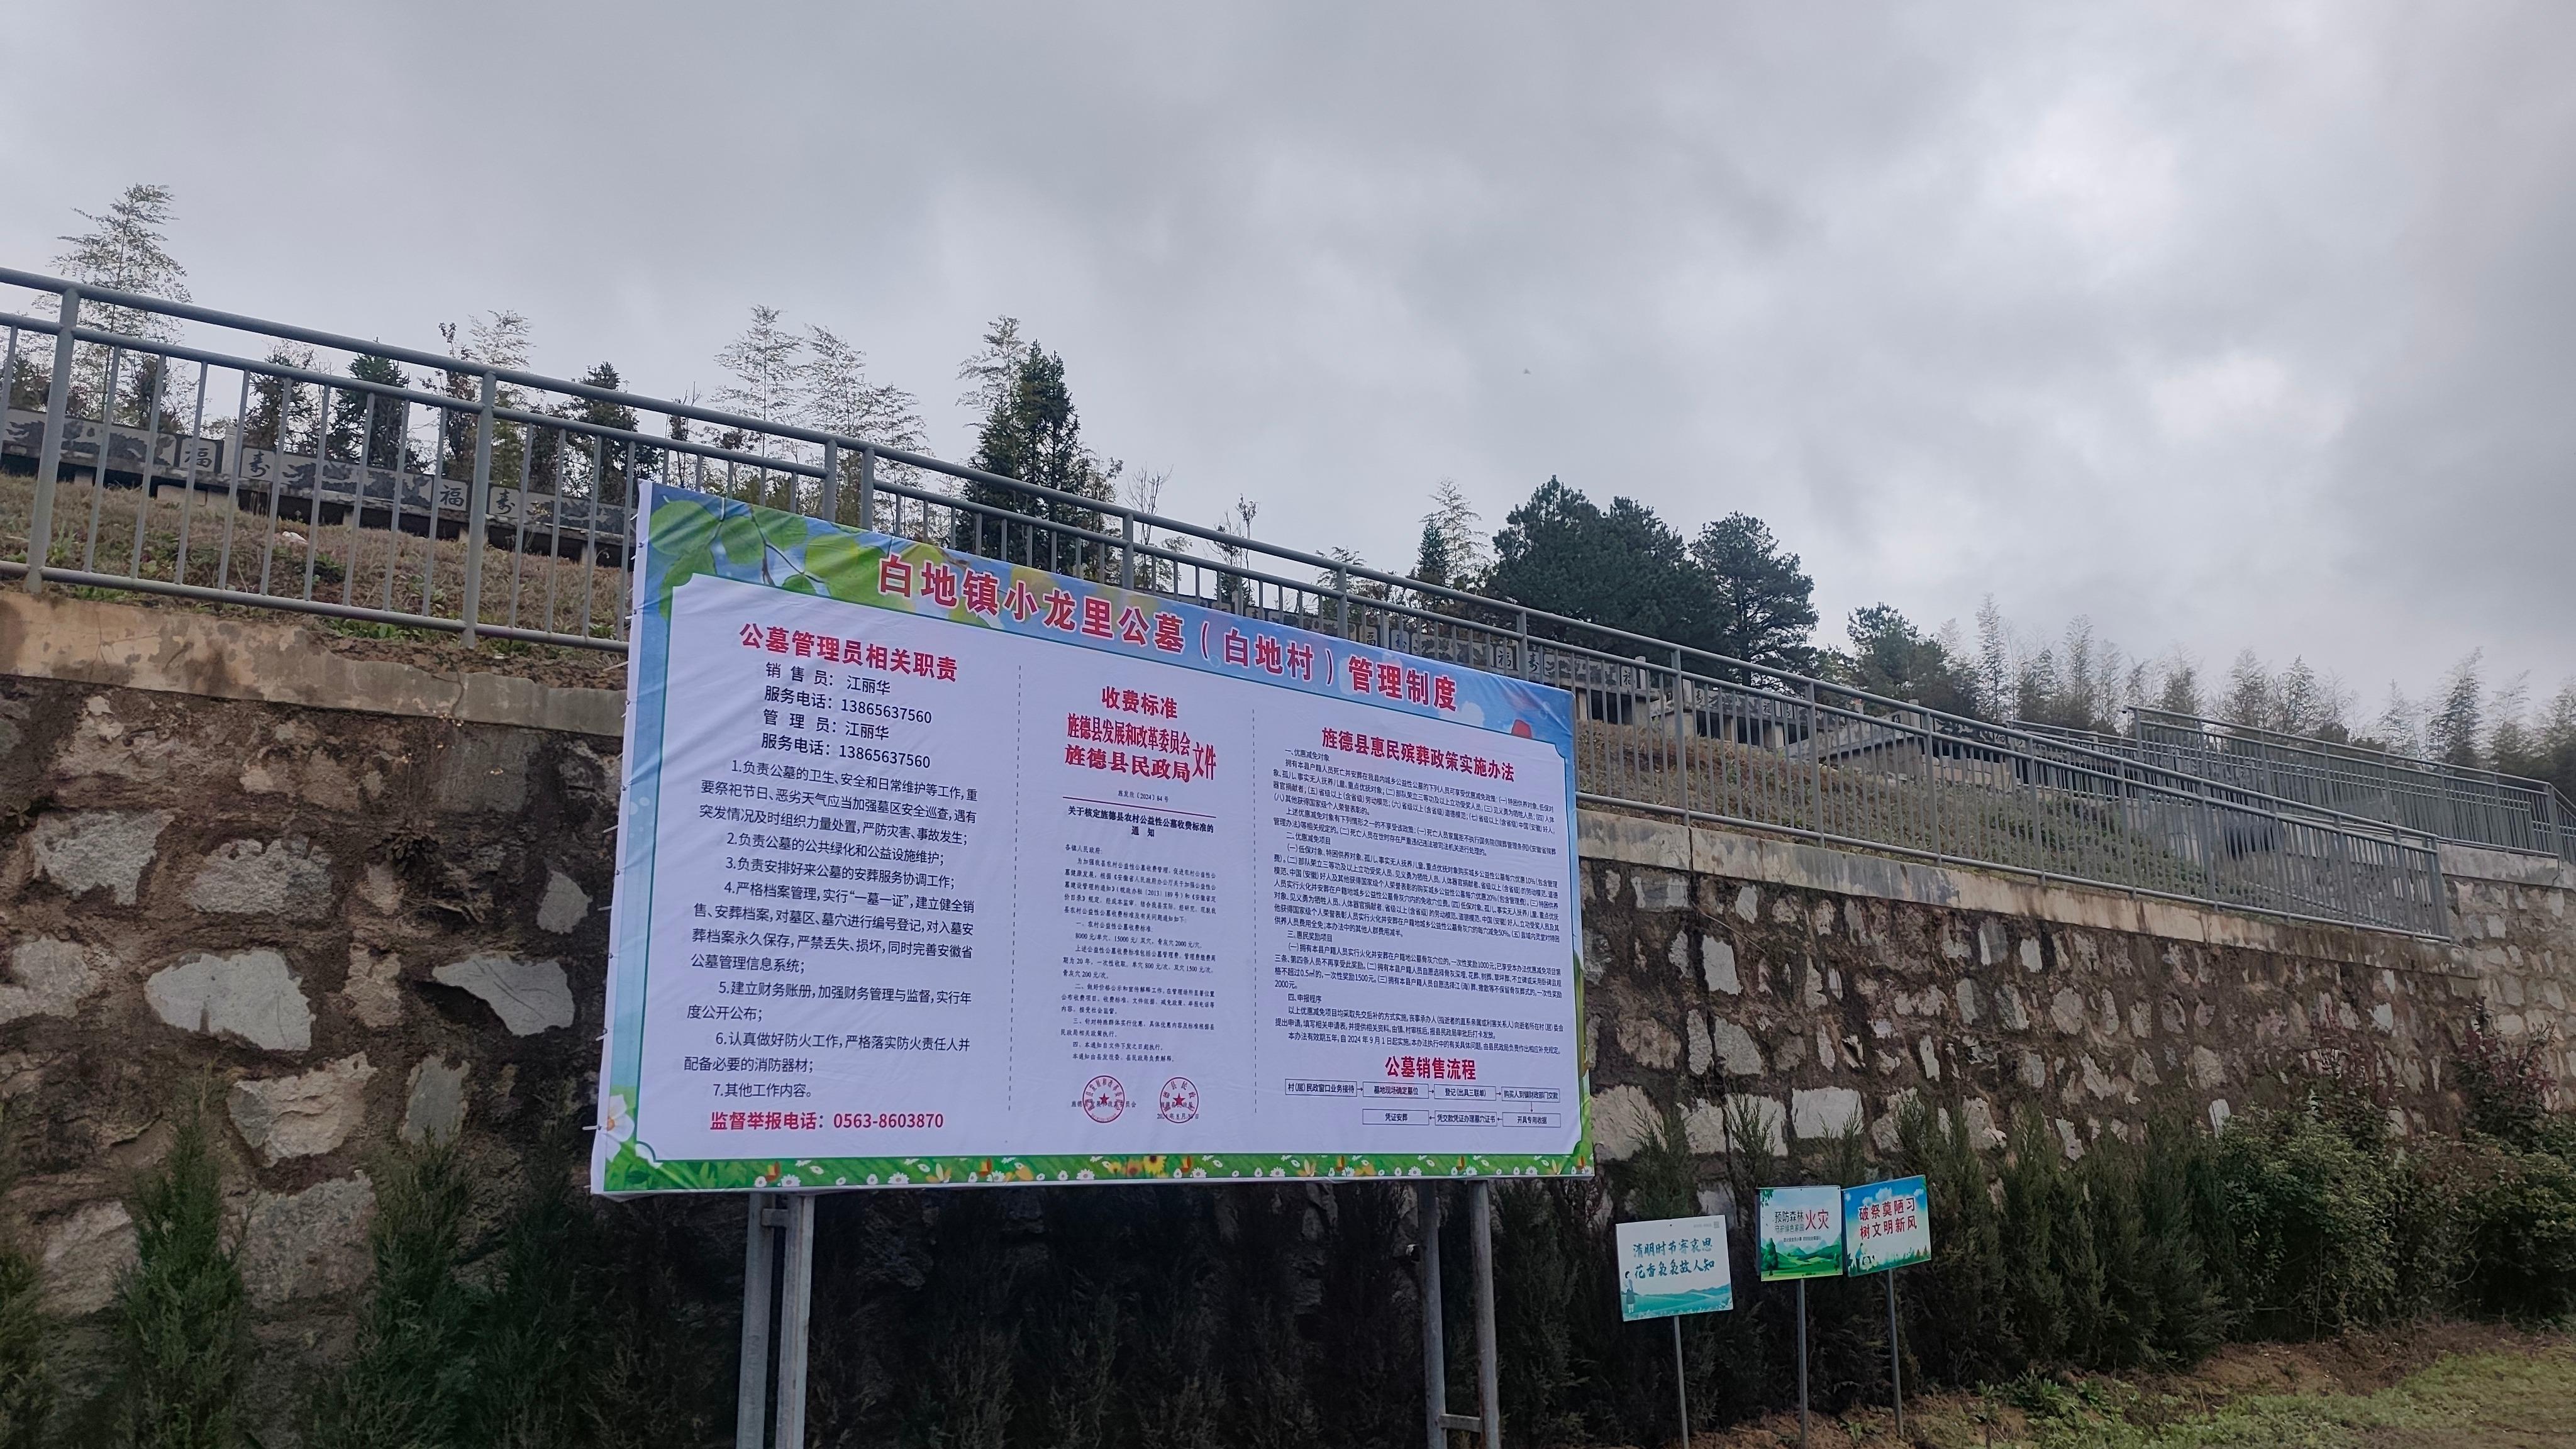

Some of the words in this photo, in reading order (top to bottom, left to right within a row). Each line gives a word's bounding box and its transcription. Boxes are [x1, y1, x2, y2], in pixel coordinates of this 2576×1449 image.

[440, 484, 465, 508] 福
[879, 553, 1457, 711] 白地镇小龙里公墓（白地村）管理制度
[740, 623, 957, 682] 公墓管理员相关职责
[1101, 685, 1178, 719] 收费标准
[1067, 712, 1191, 757] 旌德县发展和改革委员会
[1064, 743, 1191, 783] 旌德县民政局
[1191, 741, 1217, 780] 文件
[1322, 728, 1514, 780] 旌德县惠民殡葬政策实施办法
[690, 953, 804, 974] 公墓管理信息系统；
[686, 1004, 762, 1023] 度公开公布；
[683, 1055, 813, 1074] 配备必要的消防器材；
[1384, 1055, 1477, 1080] 公墓销售流程
[713, 1082, 812, 1098] 7.其他工作内容。
[1775, 1211, 1804, 1223] 预防森林
[1805, 1209, 1829, 1231] 火灾
[1858, 1197, 1916, 1221] 破祭奠陋习
[1860, 1215, 1917, 1240] 树文明新风
